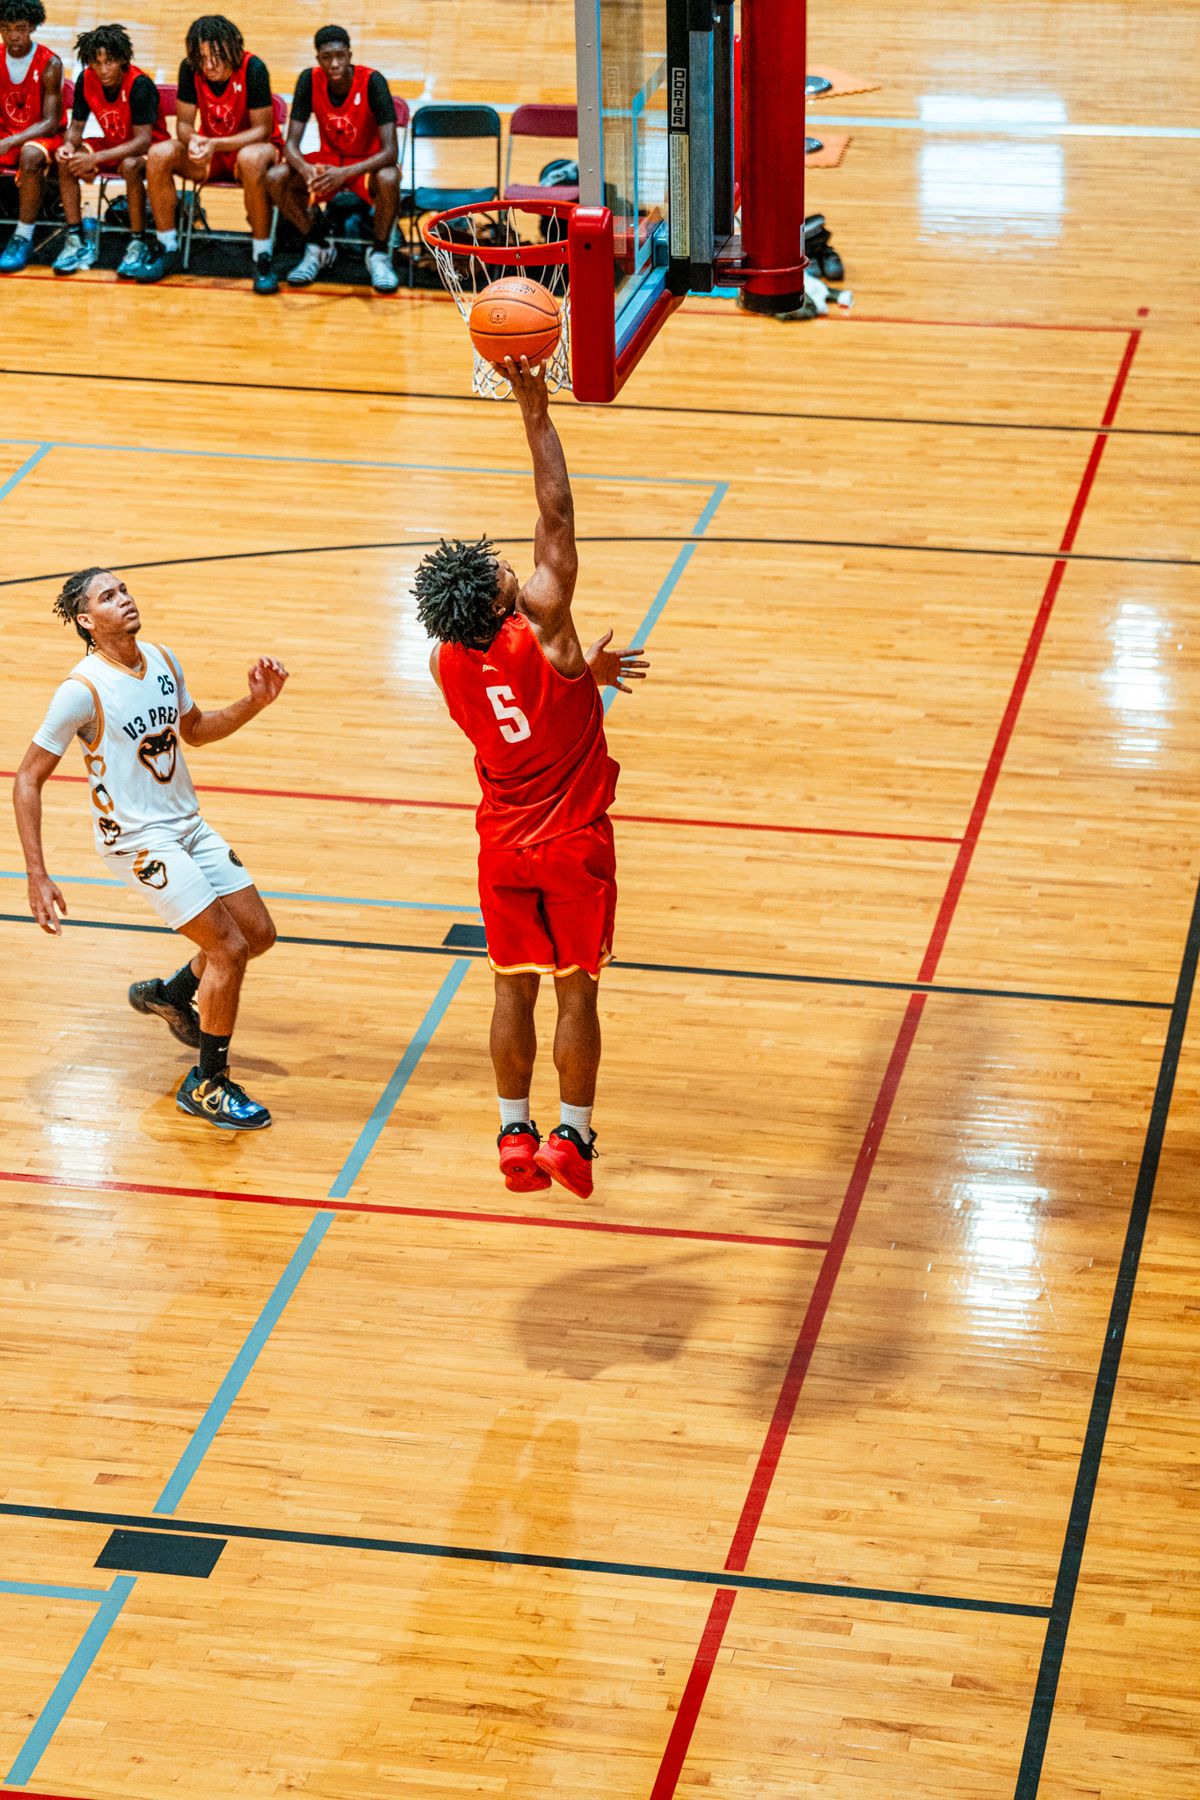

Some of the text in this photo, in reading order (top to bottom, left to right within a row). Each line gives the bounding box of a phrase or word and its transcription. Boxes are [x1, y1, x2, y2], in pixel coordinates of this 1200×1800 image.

[673, 69, 686, 125] PORTER
[157, 674, 174, 696] 25
[122, 715, 147, 741] V3
[486, 685, 531, 744] 5
